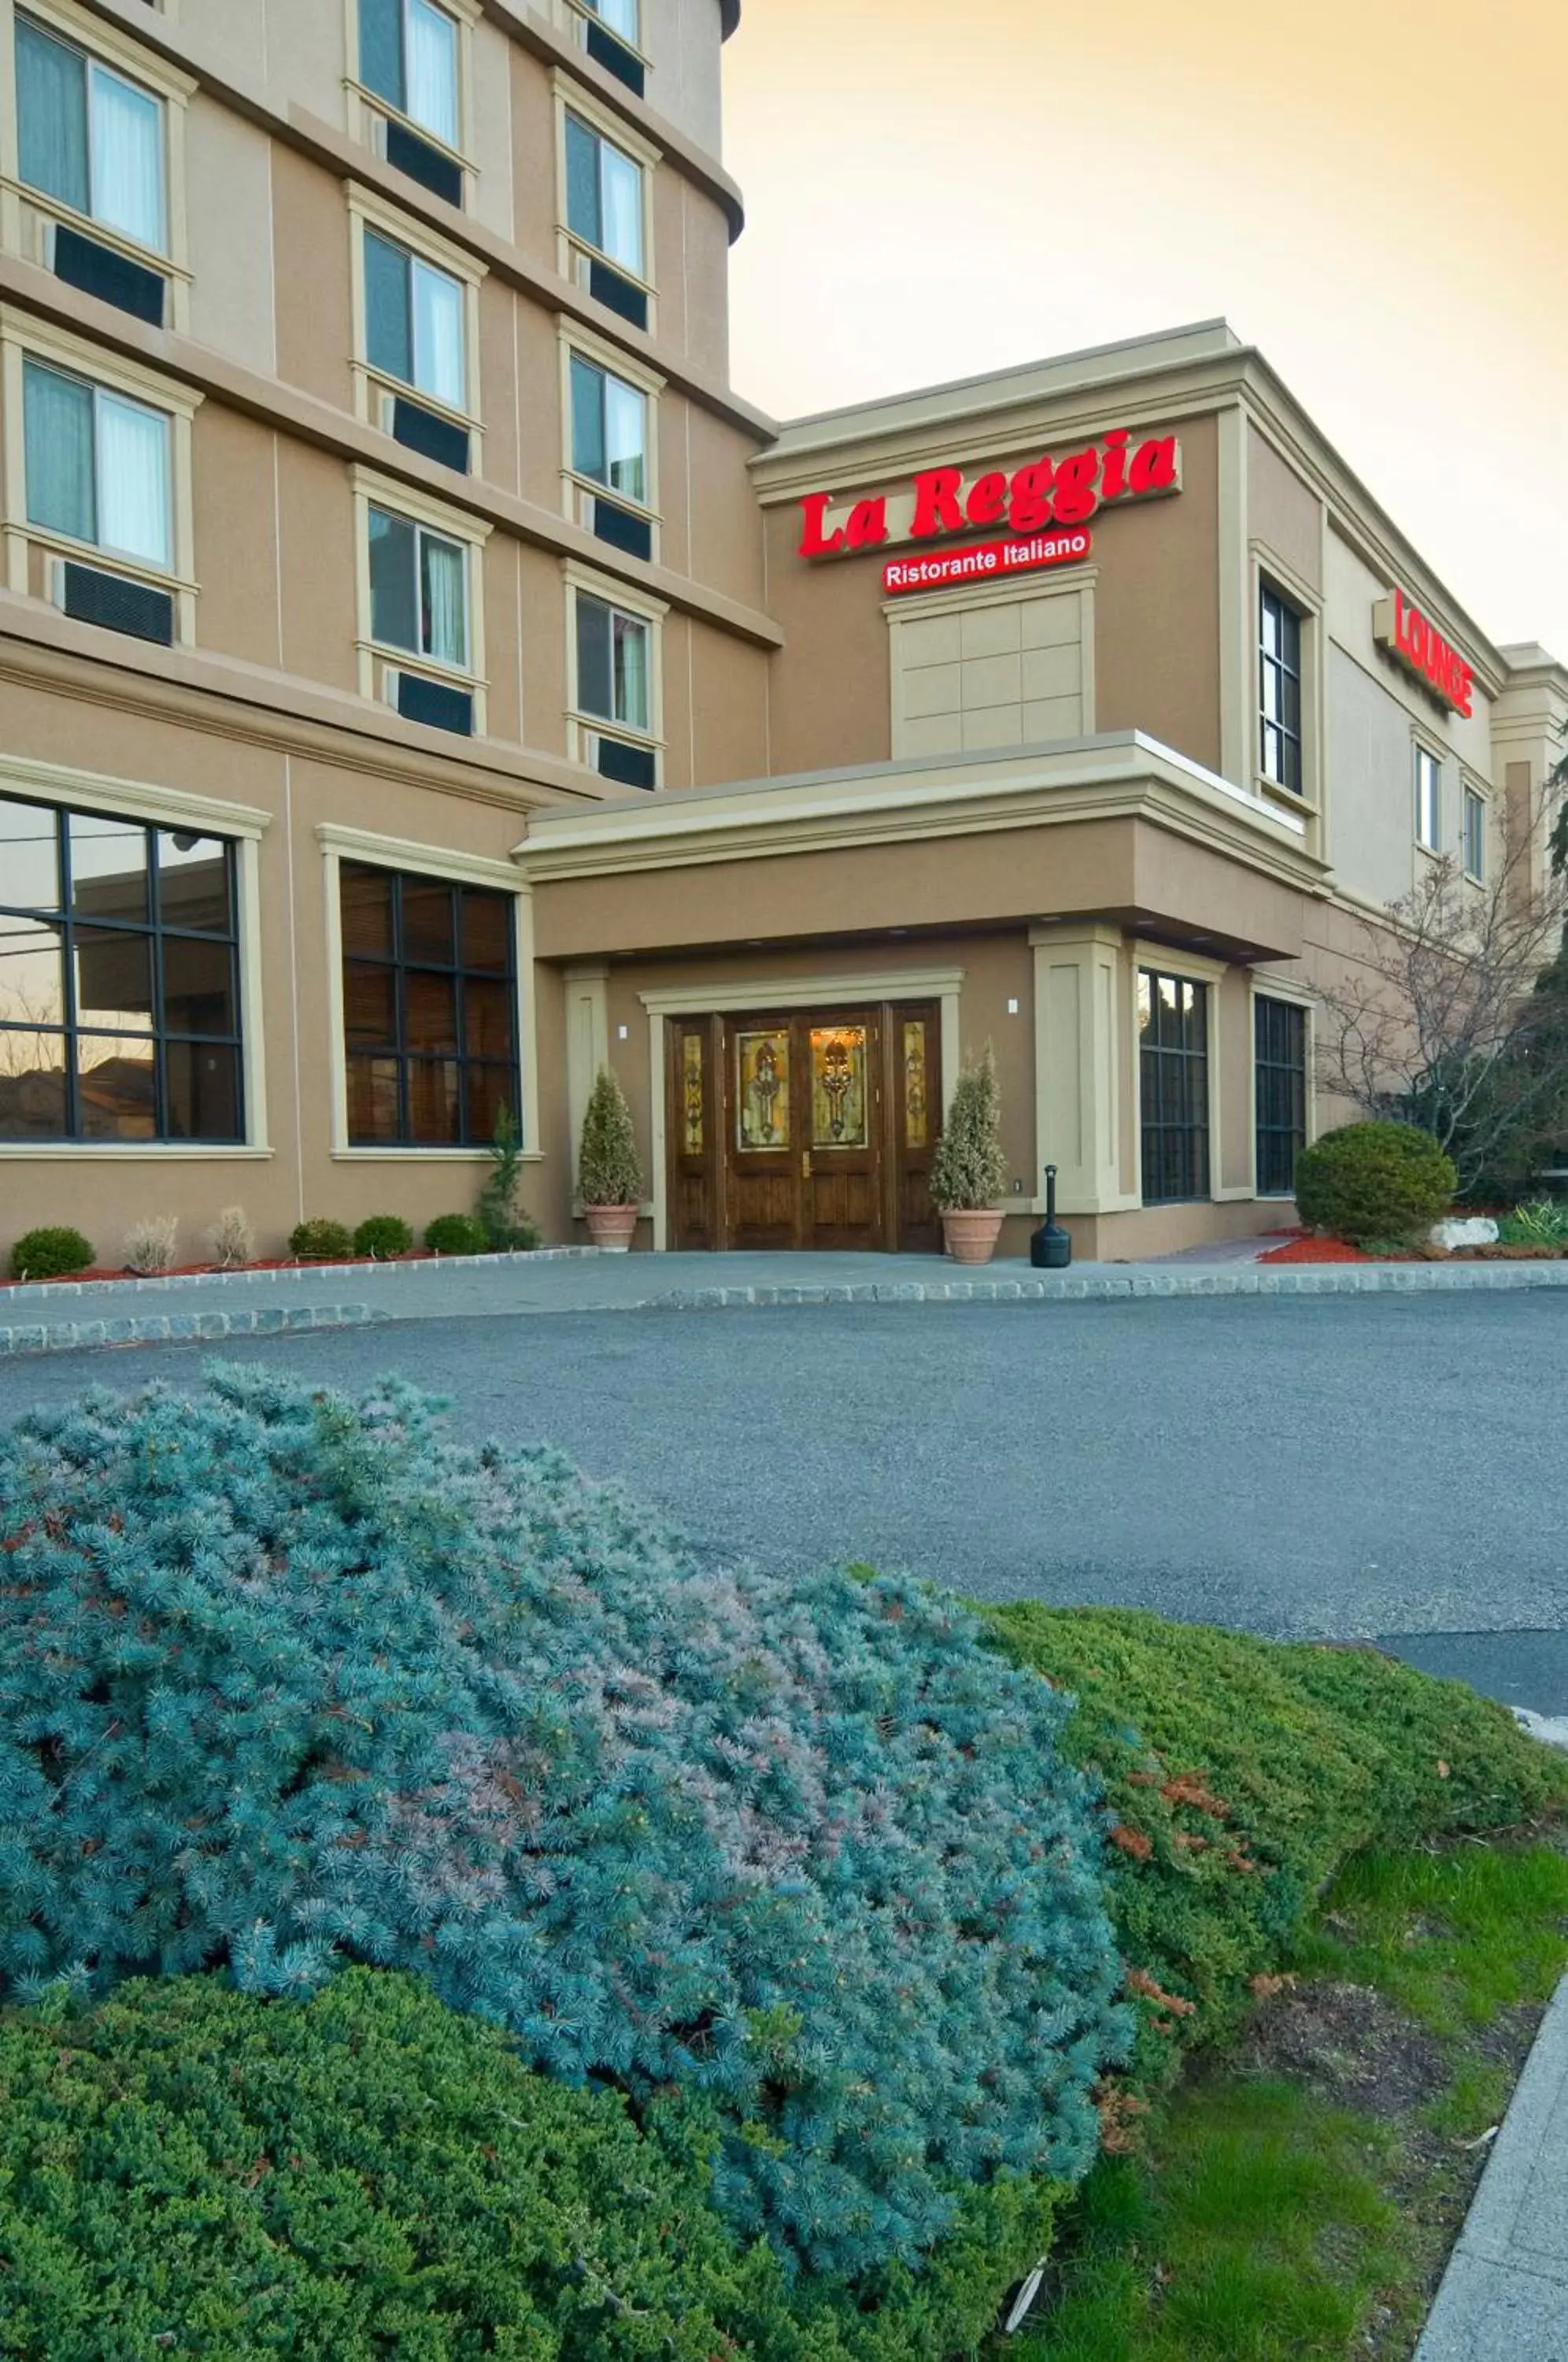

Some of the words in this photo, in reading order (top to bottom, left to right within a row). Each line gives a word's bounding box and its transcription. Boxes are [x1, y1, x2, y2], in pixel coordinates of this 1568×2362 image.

[799, 493, 886, 557] La
[910, 428, 1176, 533] Reggia
[886, 550, 996, 587] Ristorante
[1004, 535, 1085, 565] Italiano
